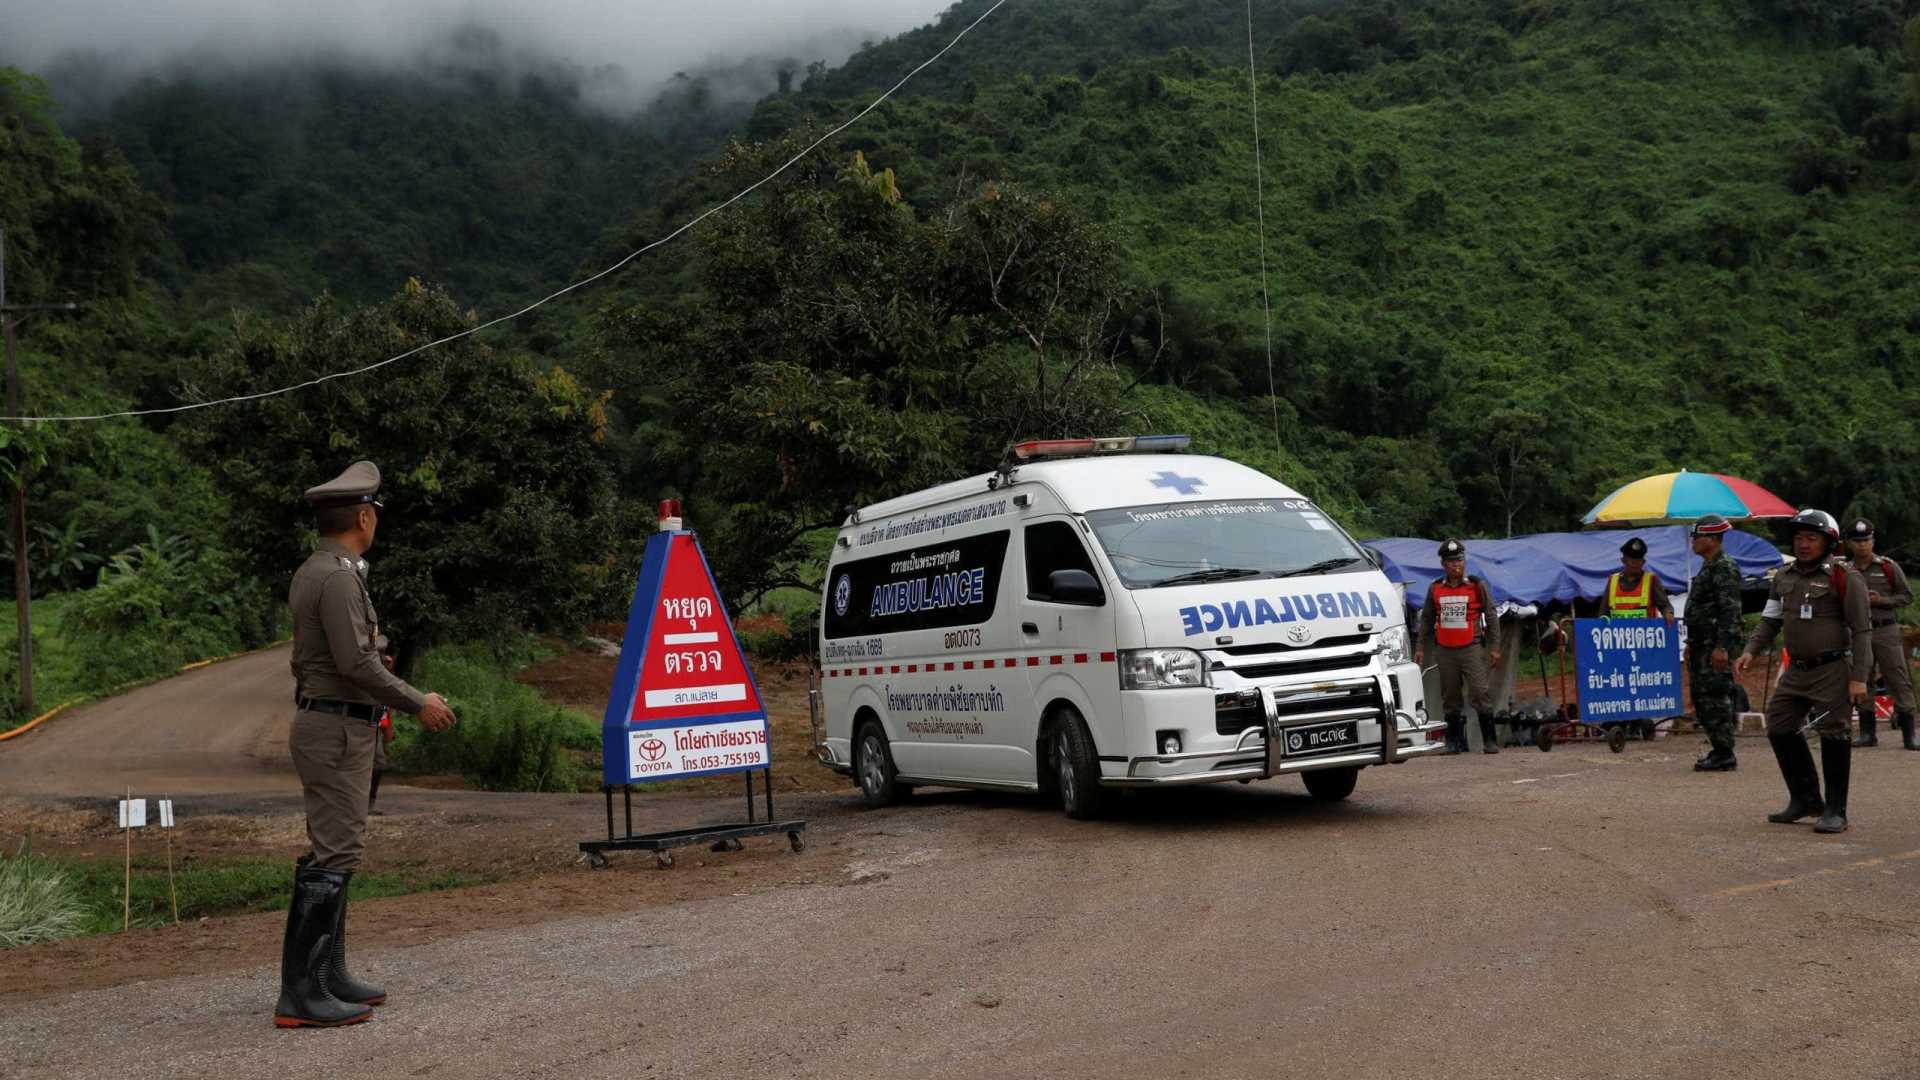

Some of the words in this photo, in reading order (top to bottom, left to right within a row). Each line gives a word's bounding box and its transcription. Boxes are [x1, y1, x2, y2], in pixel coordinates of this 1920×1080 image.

[890, 549, 961, 574] ถวายเป็นพระราชกุศล
[870, 566, 985, 618] AMBULANCE
[663, 596, 713, 632] หยุด
[866, 638, 883, 657] 1669
[1591, 626, 1666, 663] จุดหยุดรถ
[664, 650, 723, 675] ตรวจ
[1588, 668, 1624, 689] รับ-ส่ง
[1628, 666, 1672, 694] ผู้โดยสาร
[885, 684, 1004, 713] โรงพยาบาลค่ายพิชัยดาบหัก
[1588, 699, 1631, 715] งานจราจร
[673, 729, 766, 752] โตโยต้าเชียงราย
[634, 761, 673, 773] TOYOTA
[682, 751, 761, 771] โทร.053-755199
